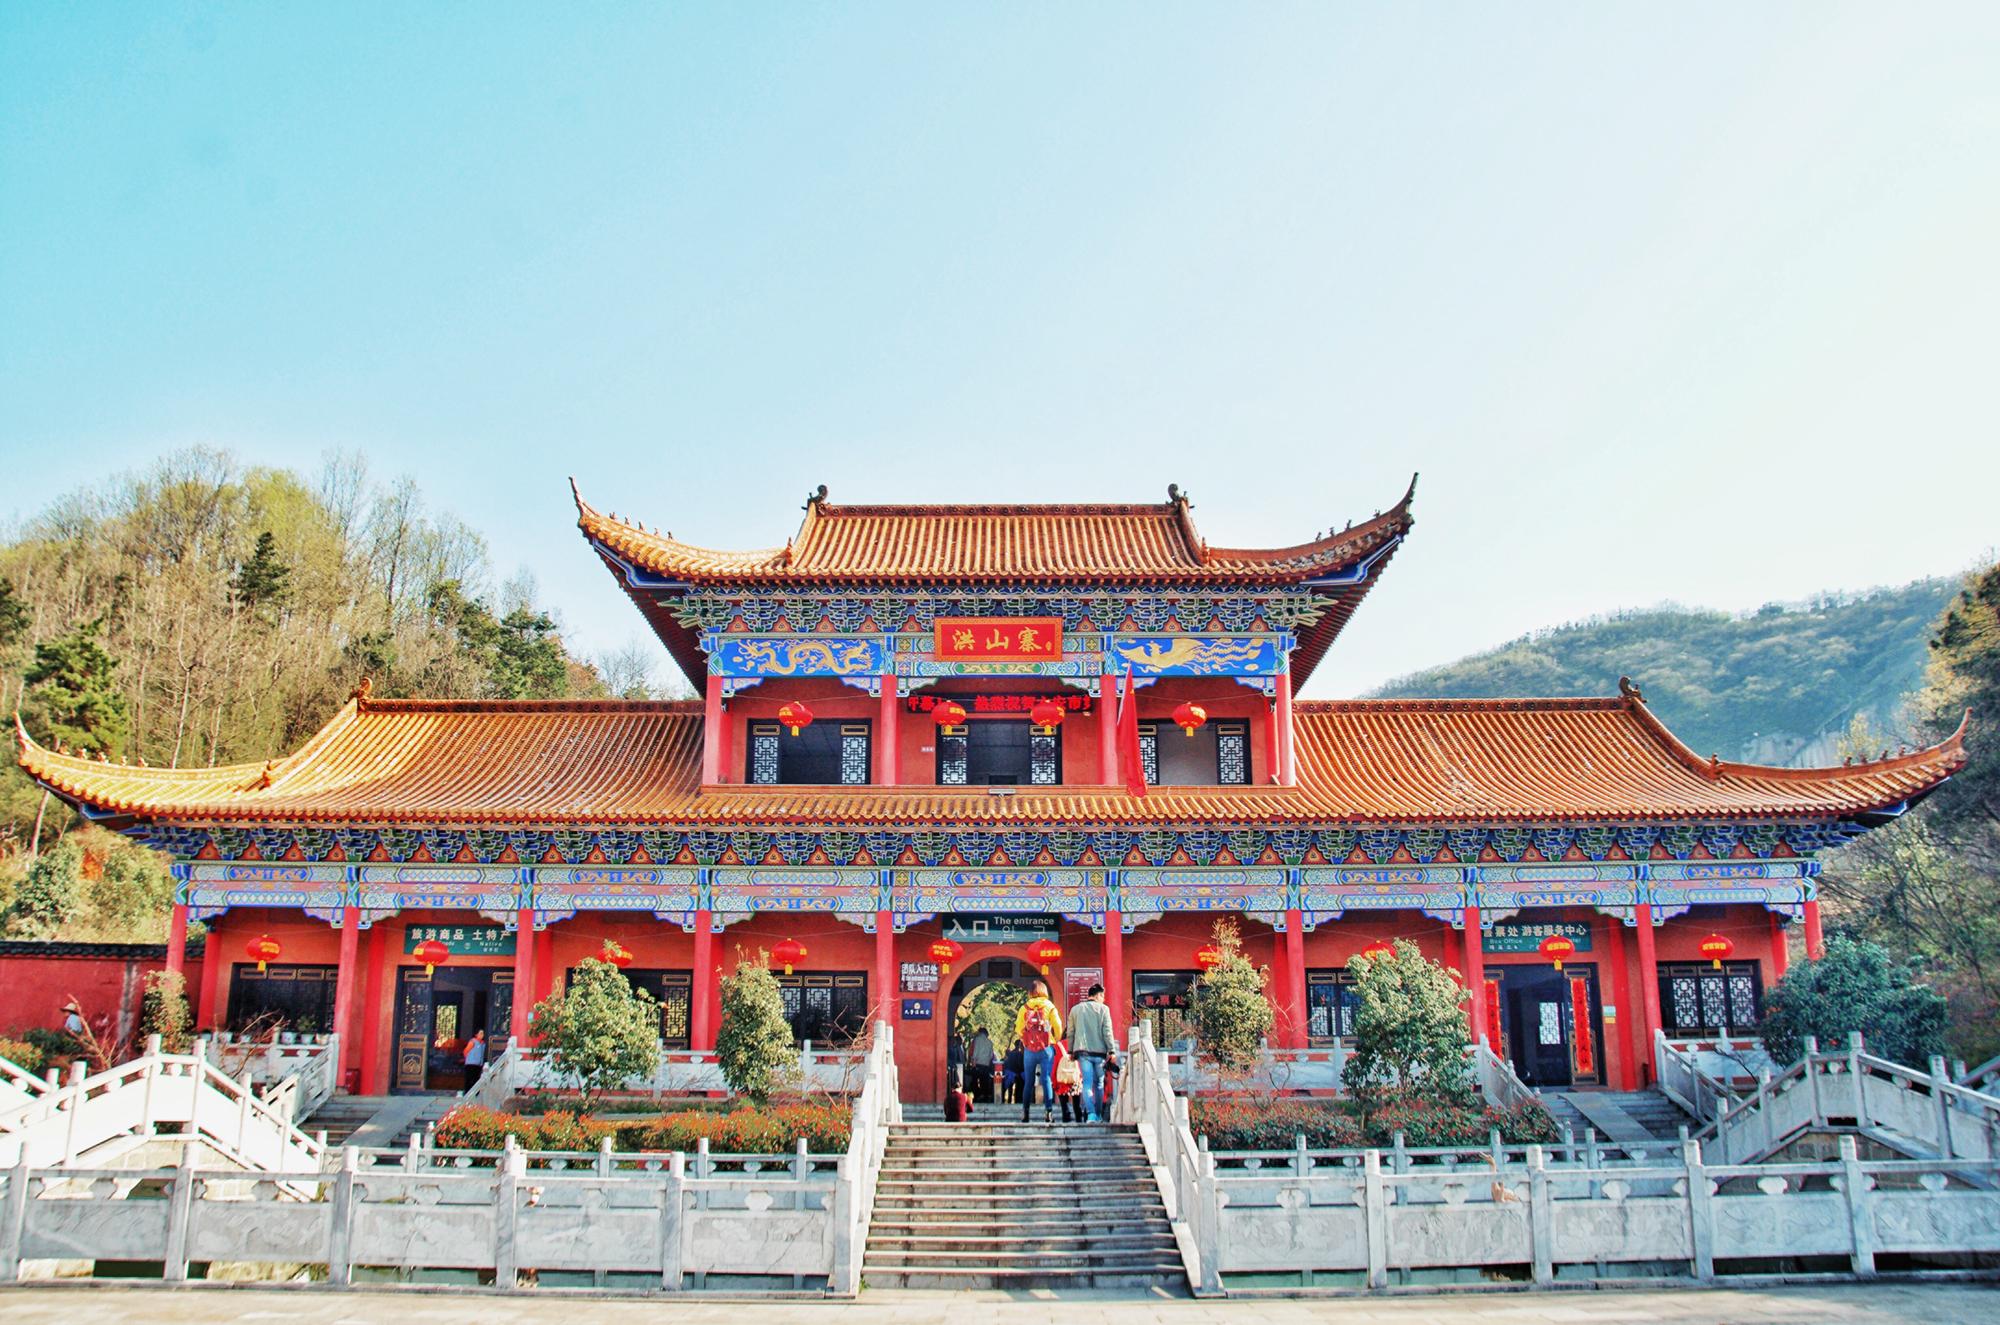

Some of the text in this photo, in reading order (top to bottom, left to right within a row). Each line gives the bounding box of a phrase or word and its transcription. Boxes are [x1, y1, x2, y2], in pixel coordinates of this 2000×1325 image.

[952, 627, 1042, 652] 洪山寨
[994, 916, 1055, 925] The entrance
[947, 918, 989, 937] 入口
[1522, 924, 1587, 937] 游客服务中心
[411, 928, 512, 940] 旅游商品 土特产
[901, 964, 938, 975] 团队入口处
